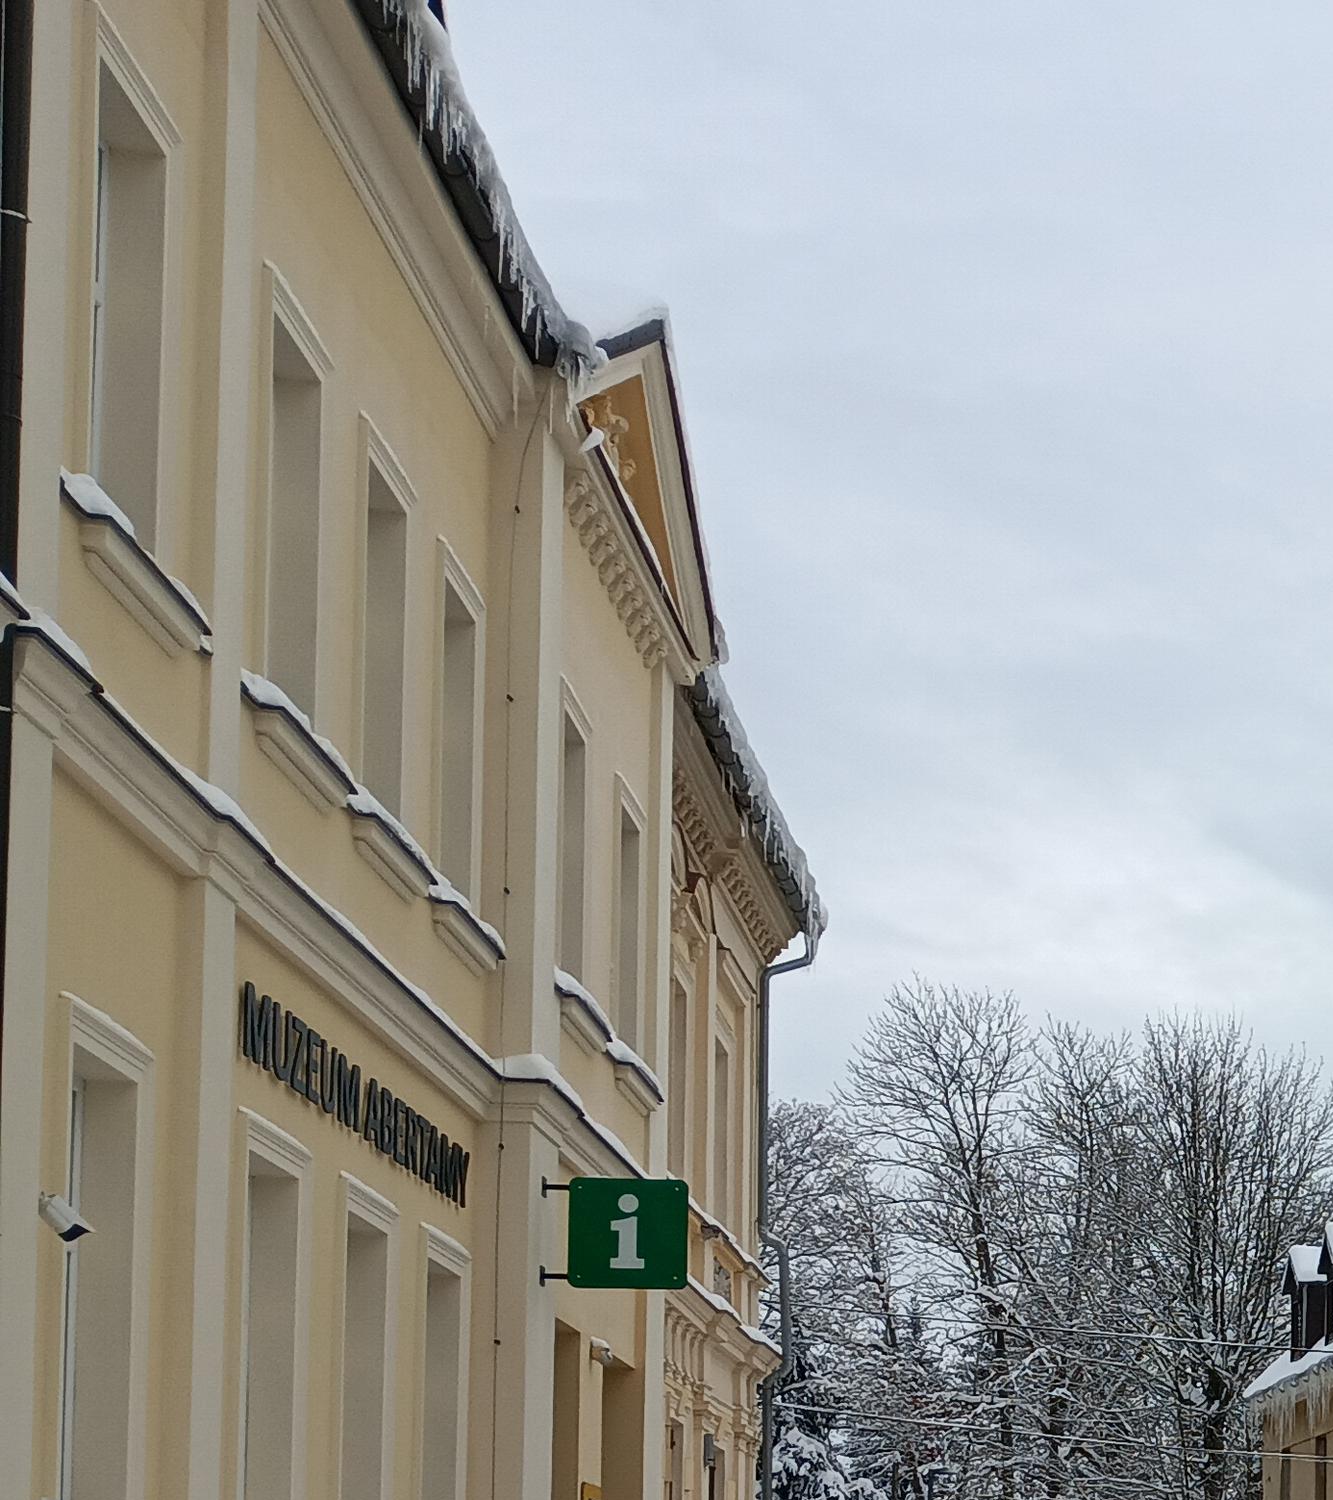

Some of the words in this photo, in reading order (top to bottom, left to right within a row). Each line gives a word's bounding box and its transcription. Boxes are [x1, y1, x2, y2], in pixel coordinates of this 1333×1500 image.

[242, 980, 361, 1133] MUZEUM
[363, 1077, 470, 1209] ABERTAMY
[609, 1193, 645, 1270] i
